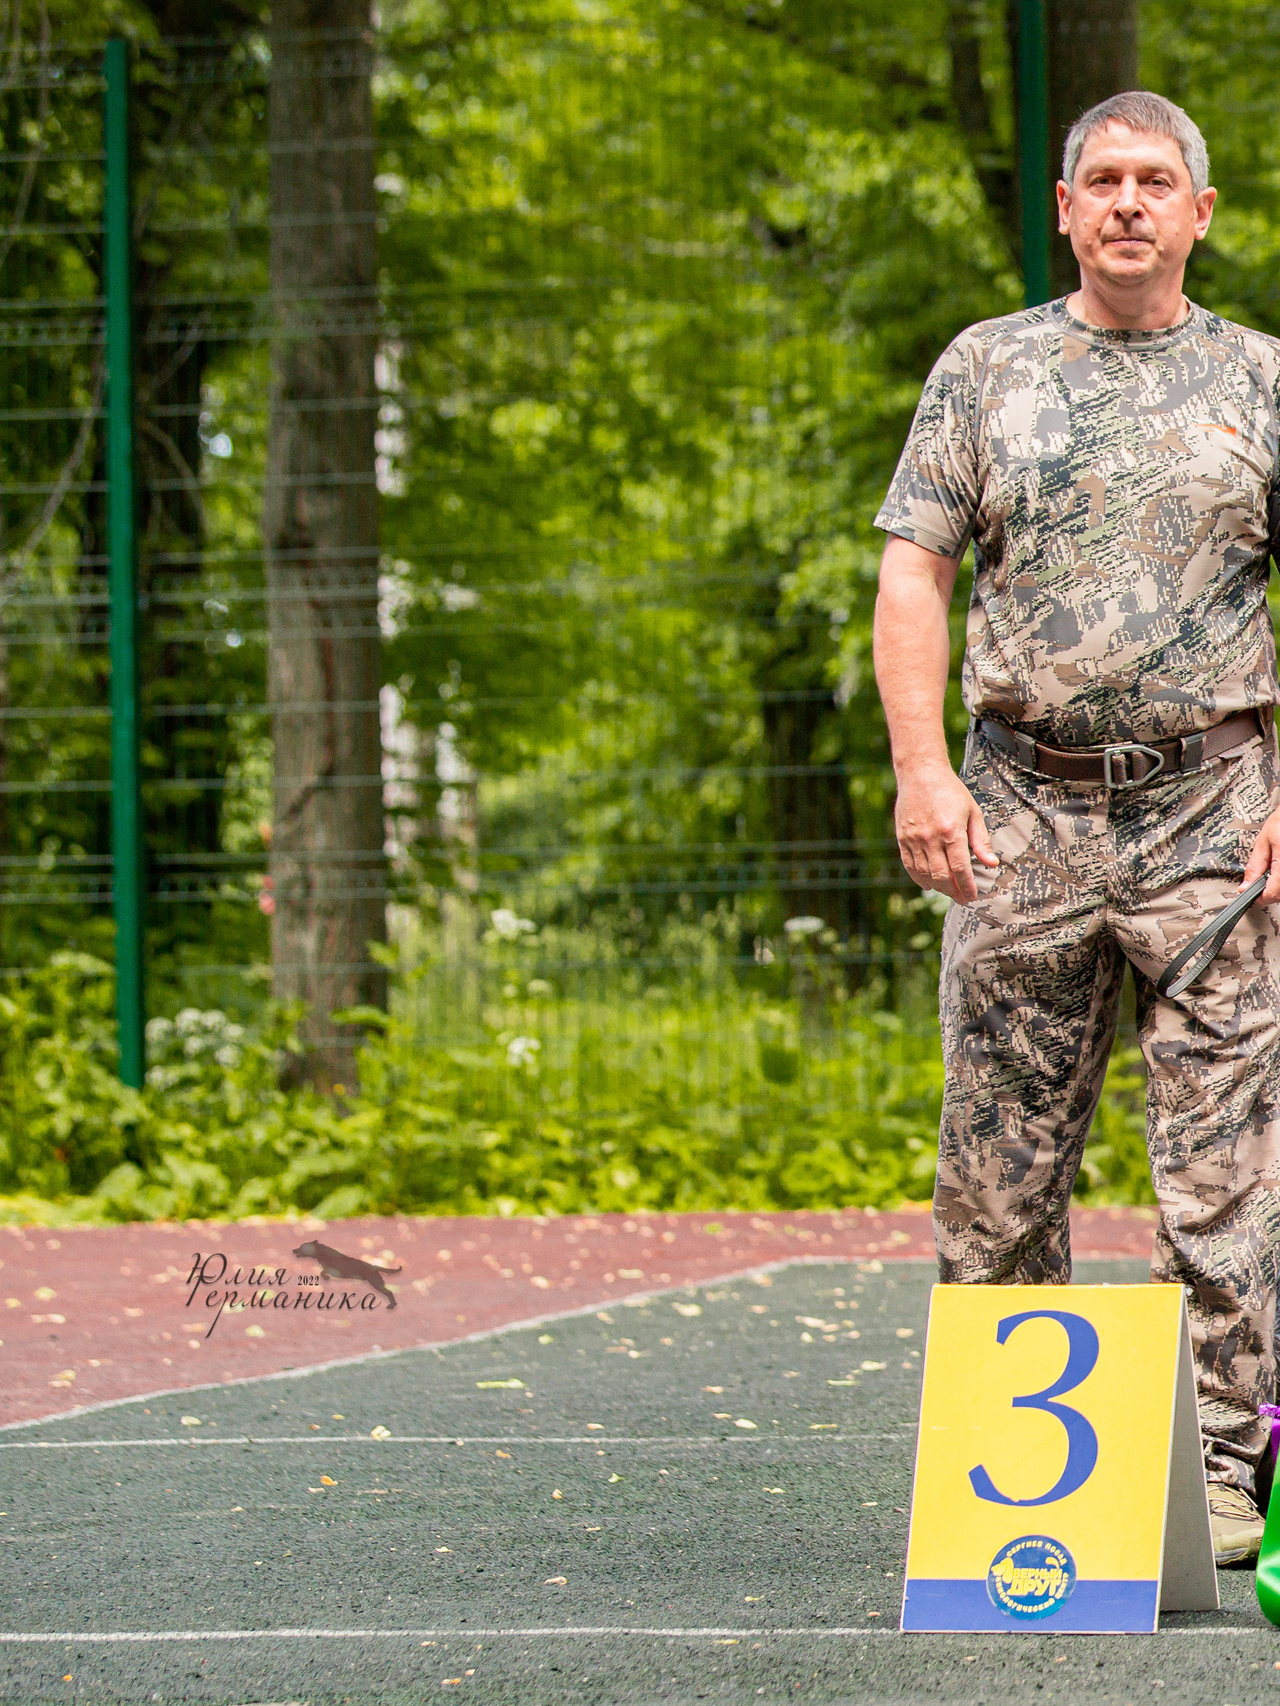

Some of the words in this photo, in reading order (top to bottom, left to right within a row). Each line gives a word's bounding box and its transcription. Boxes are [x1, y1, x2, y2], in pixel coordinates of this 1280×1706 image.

[968, 1310, 1099, 1507] 3
[1013, 1568, 1063, 1579] ВЕРНЫЙ
[1006, 1579, 1062, 1596] ДРУГ
